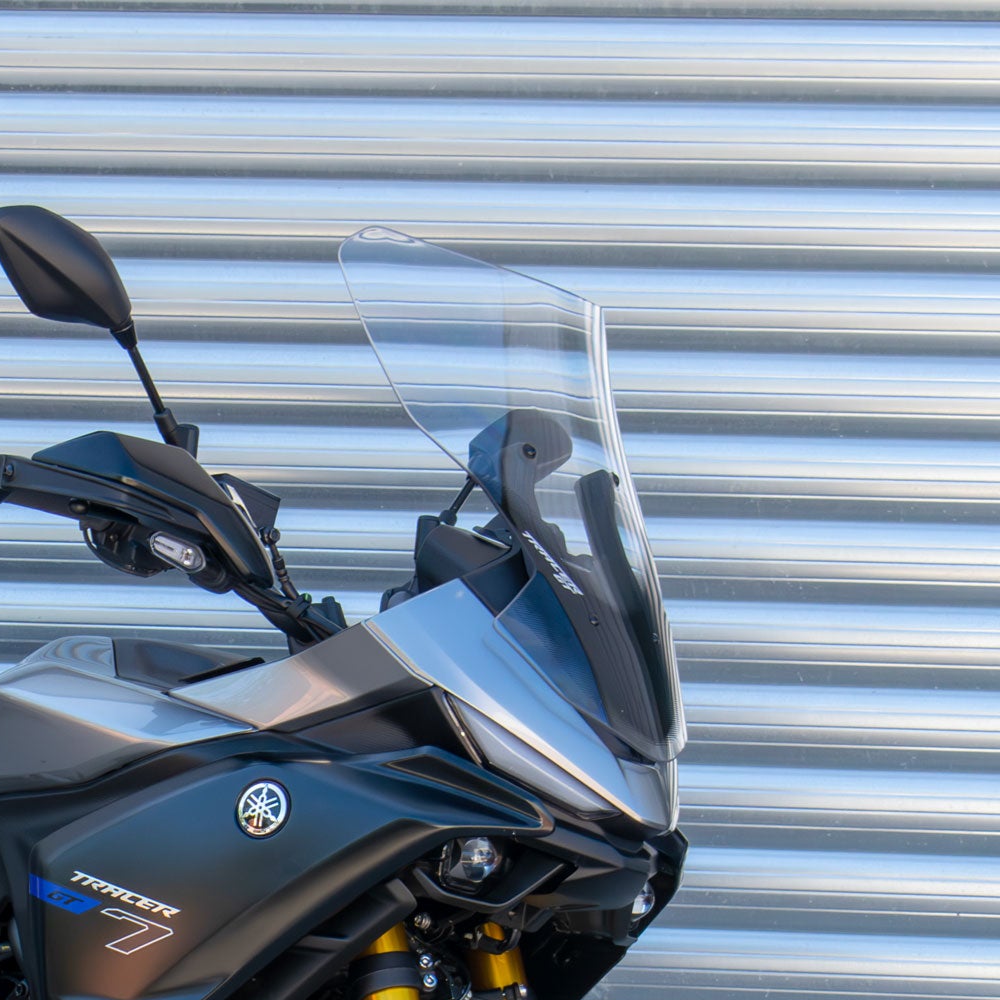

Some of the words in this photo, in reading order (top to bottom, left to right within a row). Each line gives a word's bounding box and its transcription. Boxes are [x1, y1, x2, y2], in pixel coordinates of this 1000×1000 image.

[47, 890, 85, 906] GT
[70, 870, 182, 919] TRACER
[100, 907, 175, 956] 7
